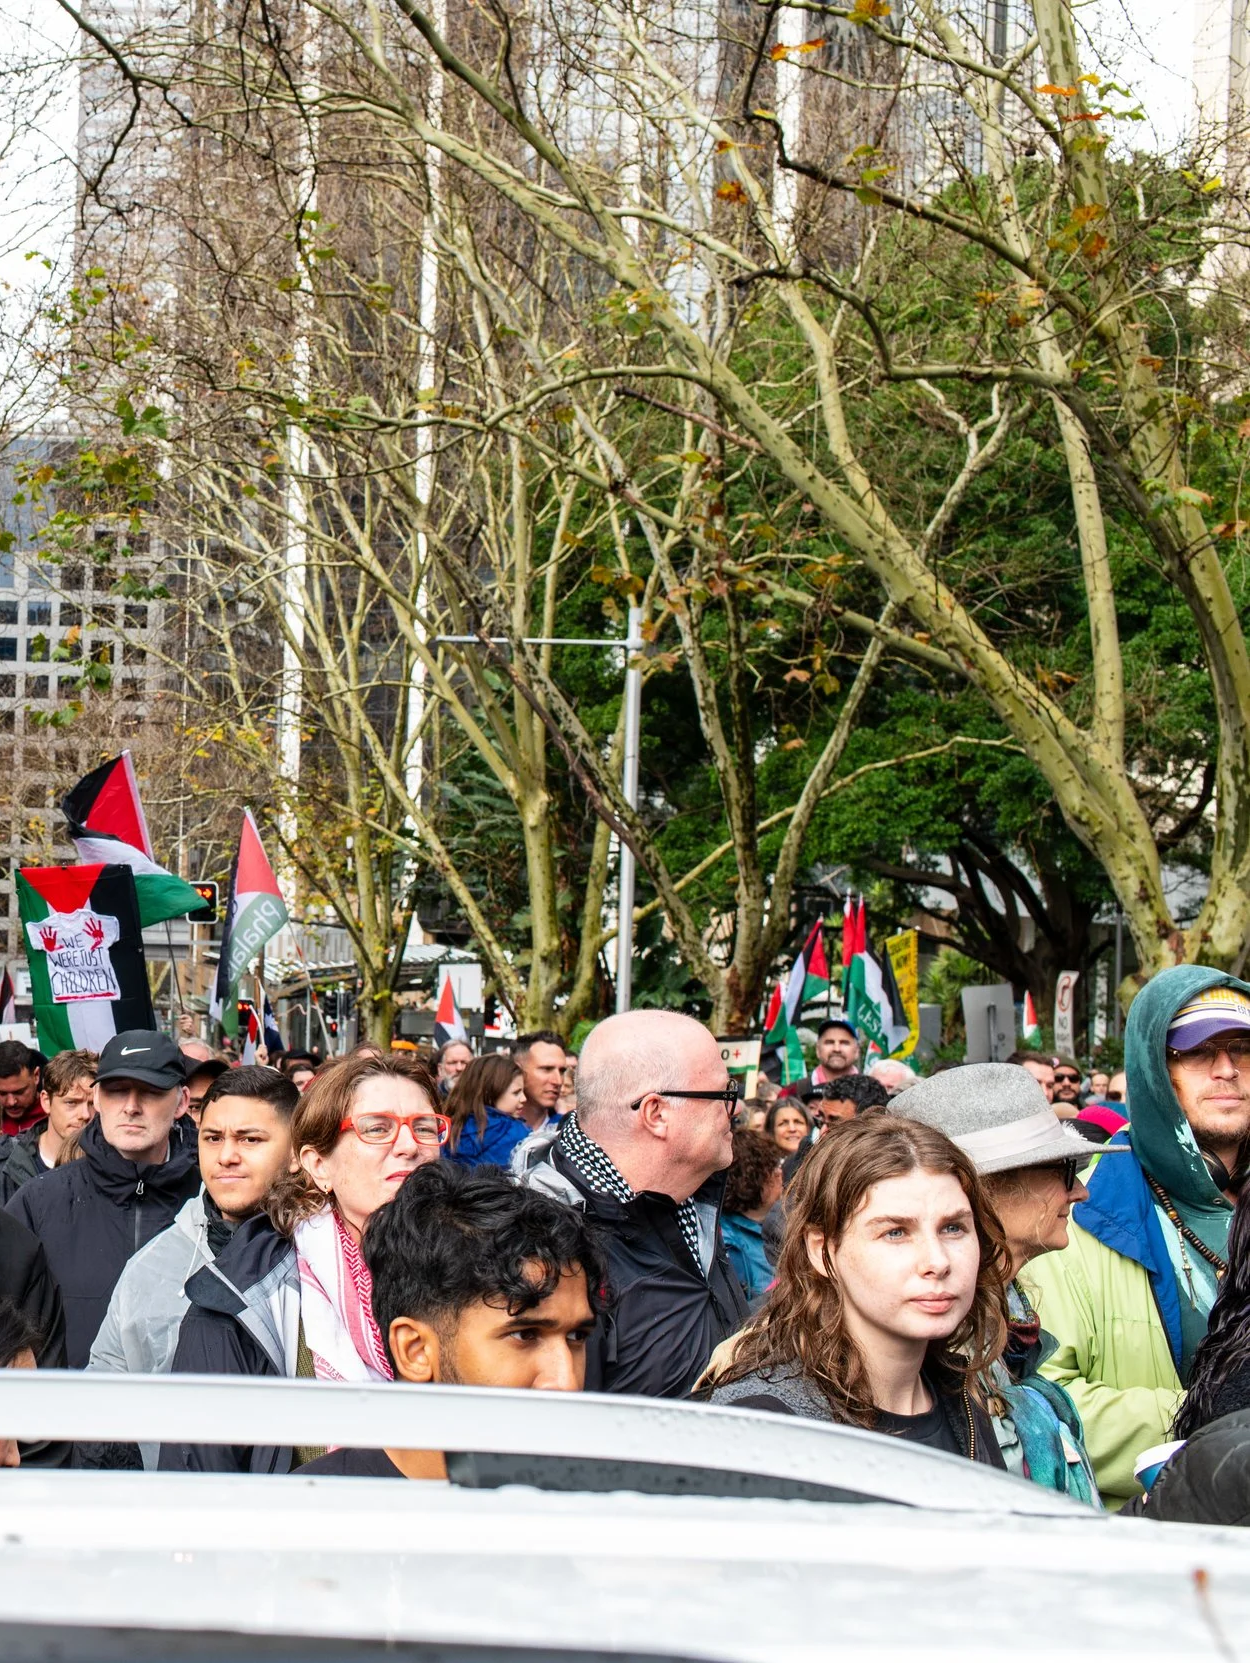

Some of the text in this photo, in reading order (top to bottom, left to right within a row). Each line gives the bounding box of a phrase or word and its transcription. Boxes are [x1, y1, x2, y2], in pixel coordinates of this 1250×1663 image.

[62, 932, 83, 949] WE
[48, 947, 104, 968] WERE JUST
[51, 968, 117, 996] CHILDREN
